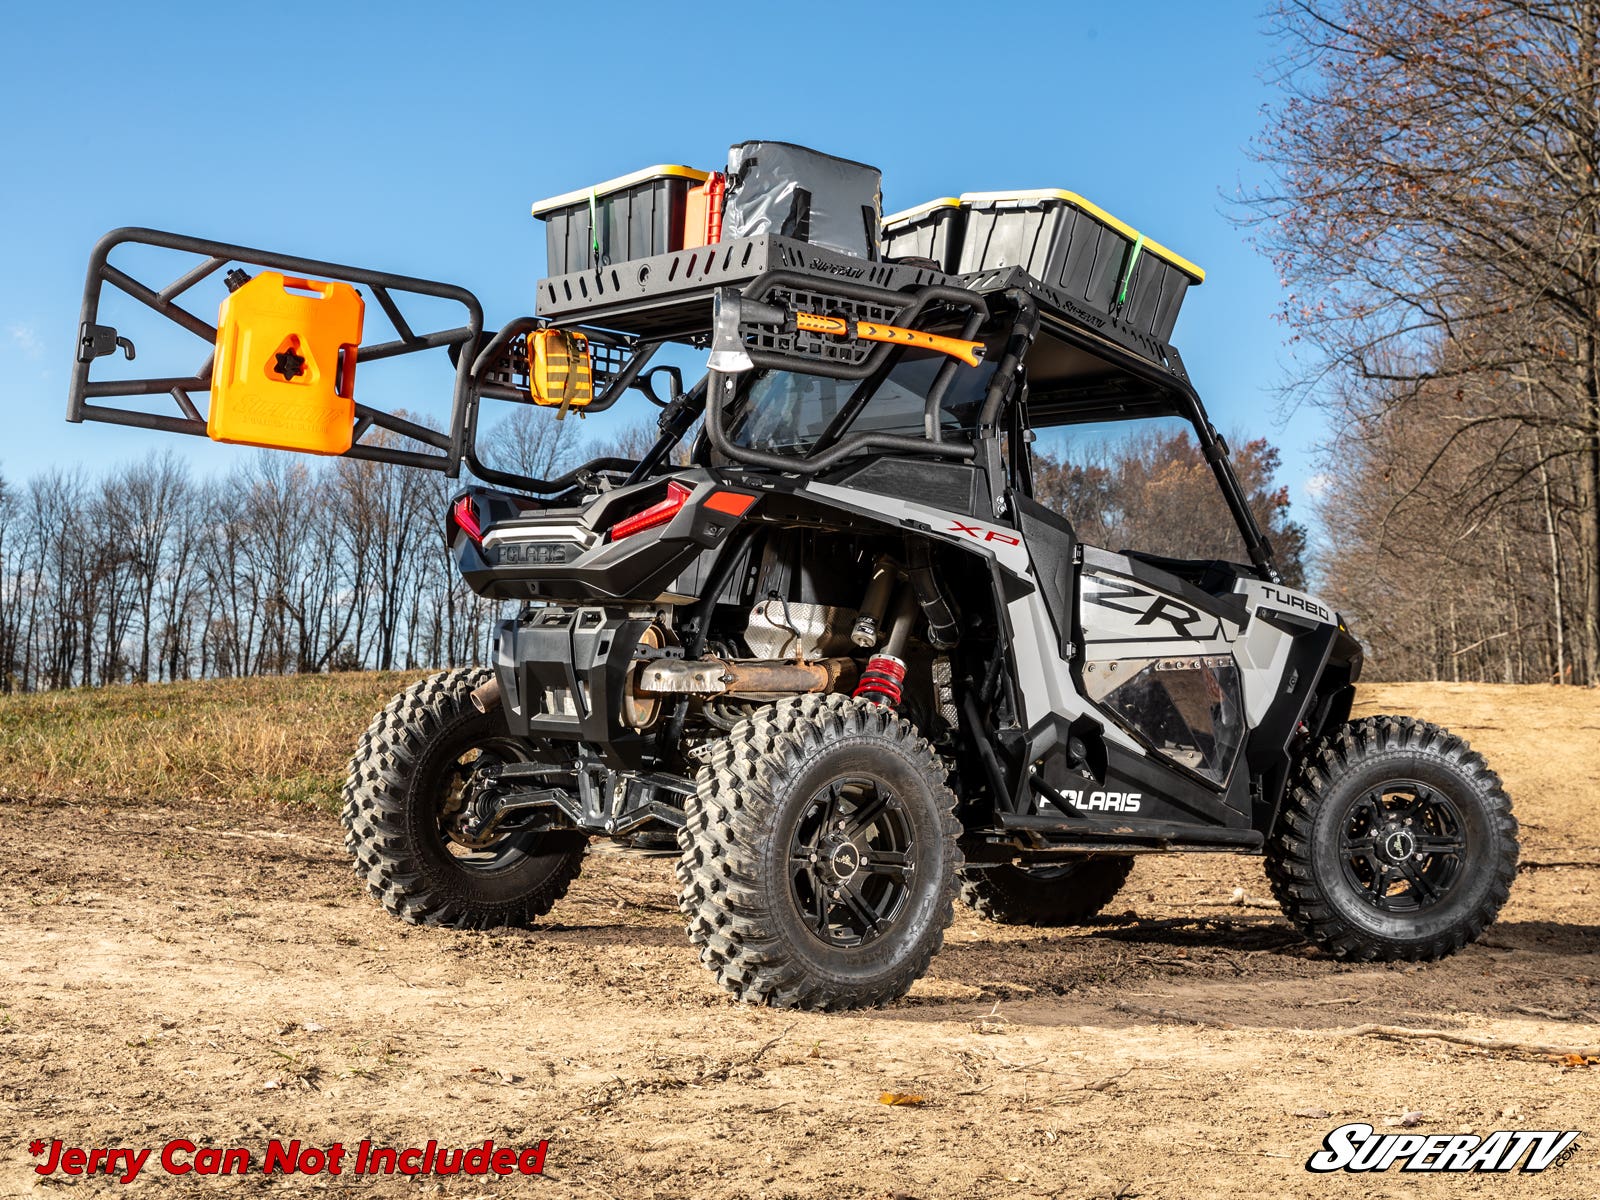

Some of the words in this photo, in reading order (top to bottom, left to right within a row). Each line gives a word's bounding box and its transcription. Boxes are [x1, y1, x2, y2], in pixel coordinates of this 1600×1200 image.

[947, 519, 1020, 546] XP
[497, 544, 566, 563] POLARIS
[1261, 586, 1330, 621] TURBO
